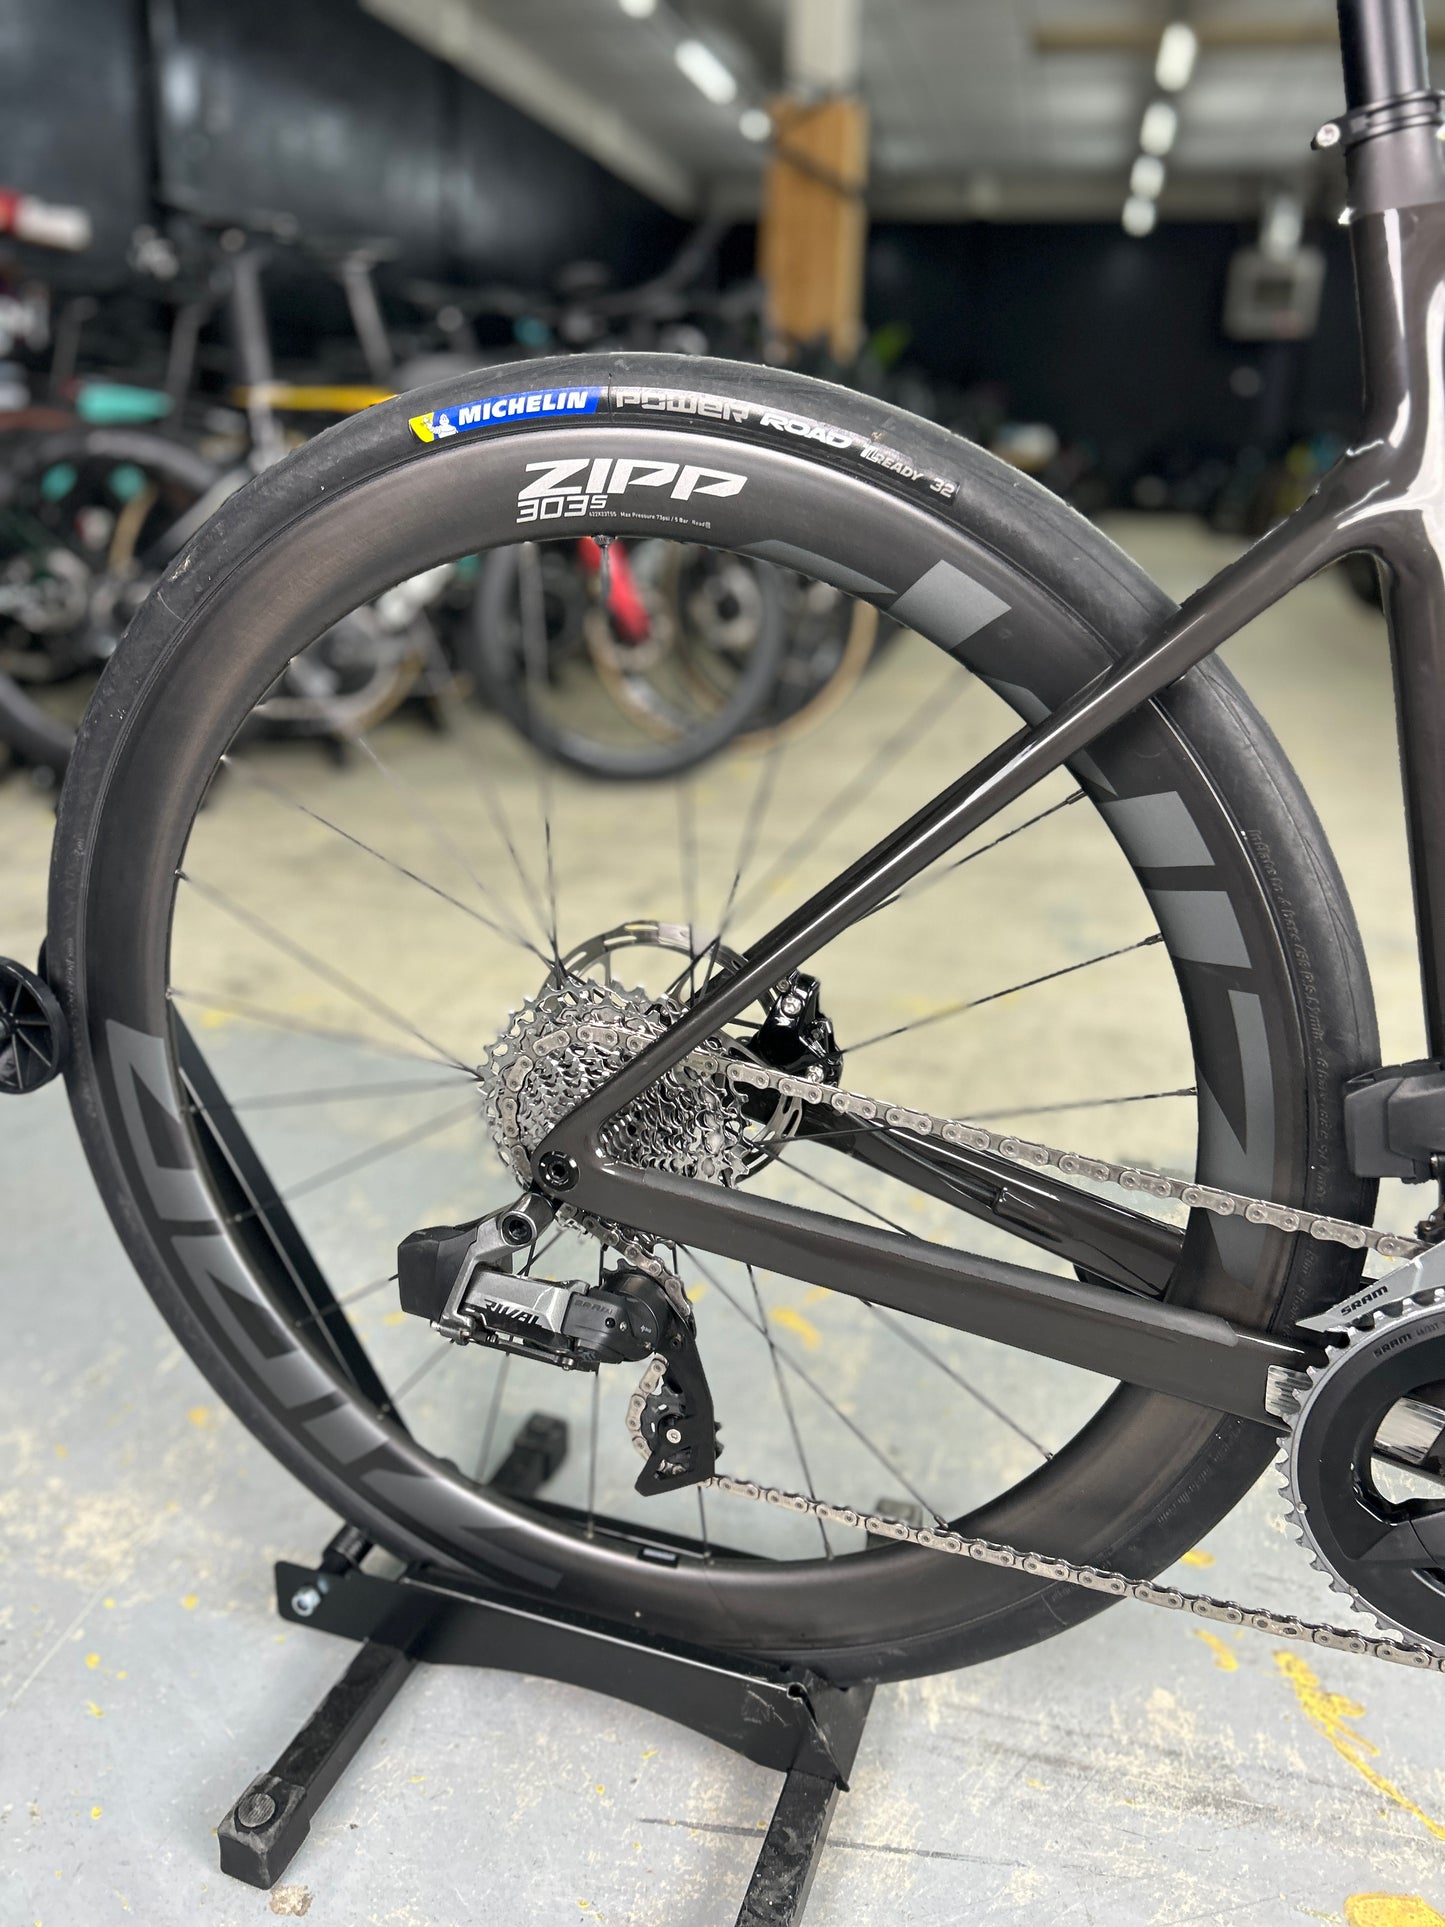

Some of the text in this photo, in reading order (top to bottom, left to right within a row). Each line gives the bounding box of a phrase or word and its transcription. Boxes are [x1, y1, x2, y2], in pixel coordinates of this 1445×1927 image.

[458, 391, 588, 425] MICHELIN
[616, 391, 750, 424] POWER
[760, 412, 853, 449] ROAD
[929, 477, 956, 498] 32
[518, 458, 748, 501] ZIPP
[631, 511, 656, 520] Pressure
[484, 1299, 542, 1328] RIVAL
[1340, 1285, 1389, 1316] SRAM
[1373, 1332, 1413, 1360] SRAM
